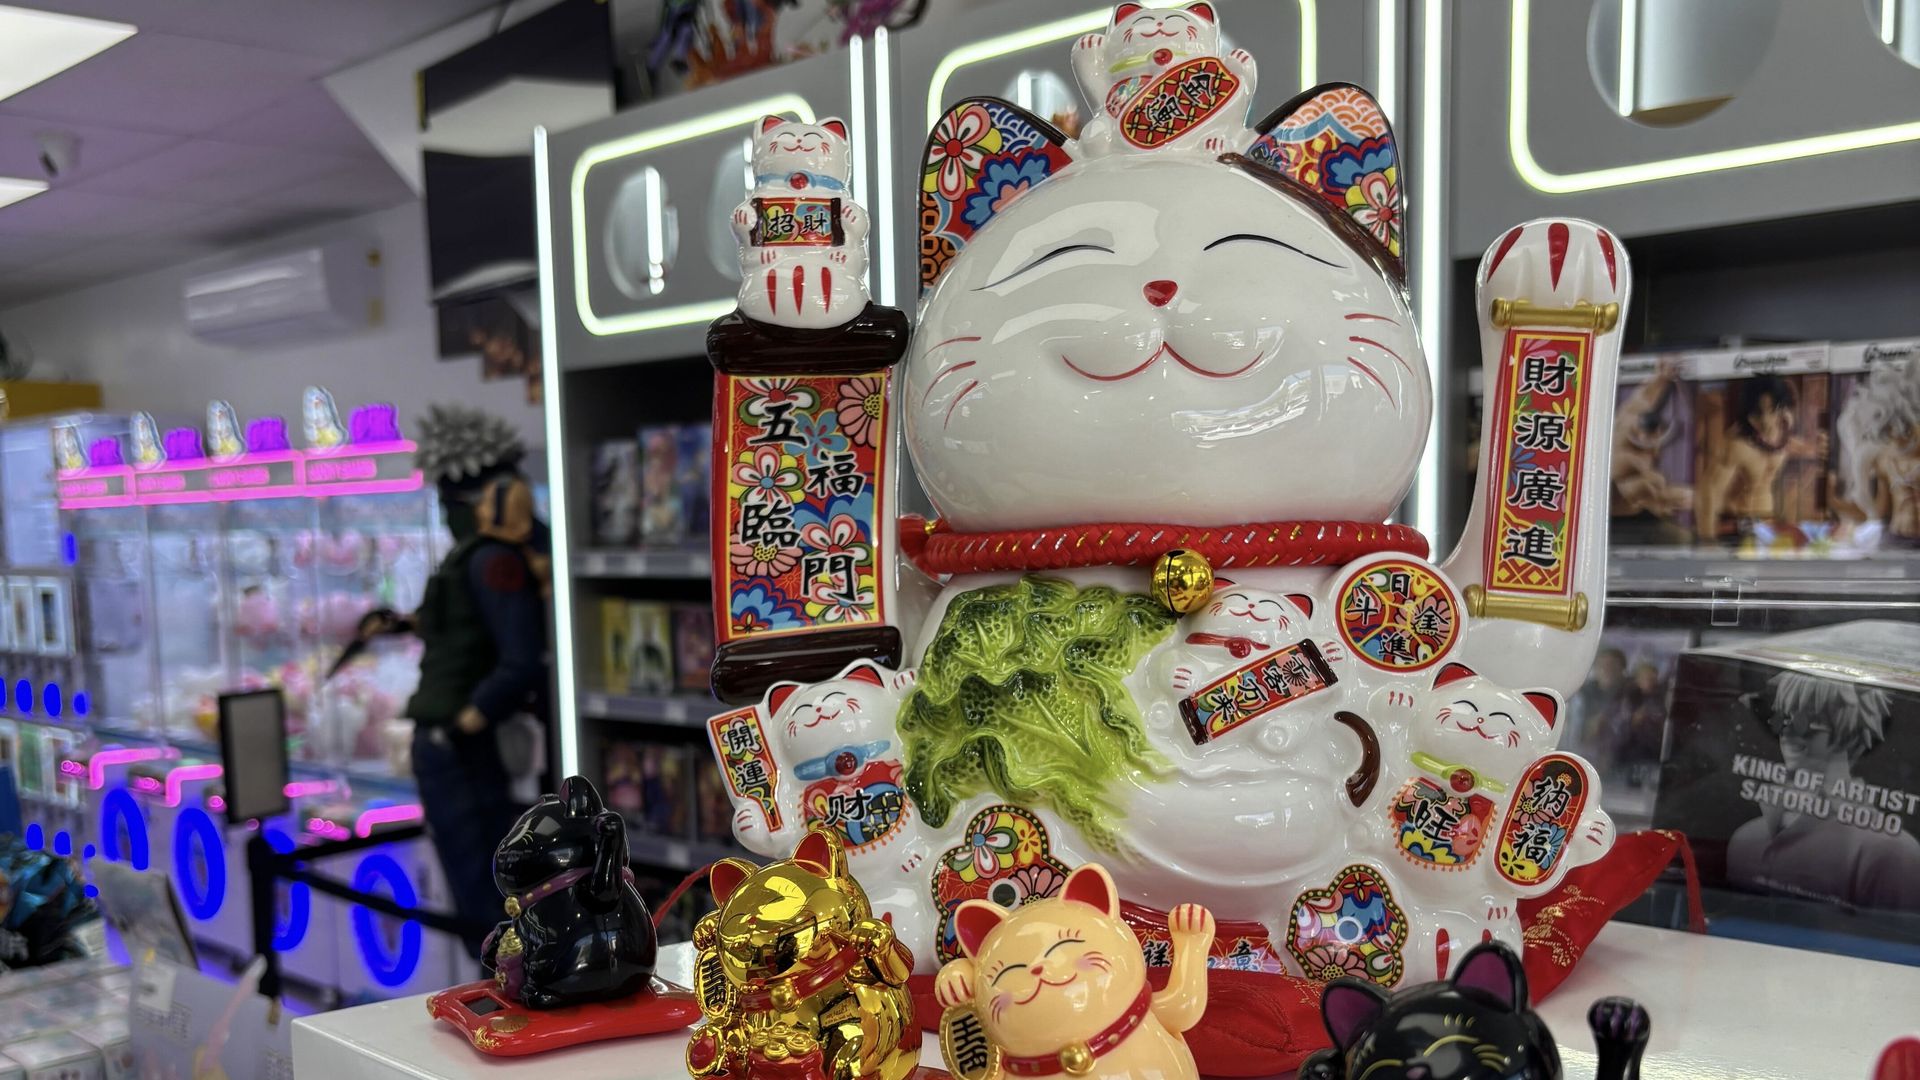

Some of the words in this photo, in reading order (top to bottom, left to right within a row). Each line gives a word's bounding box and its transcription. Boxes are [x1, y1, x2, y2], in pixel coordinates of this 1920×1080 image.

[768, 208, 828, 236] 招財
[1502, 357, 1576, 568] 財源廣進
[727, 724, 768, 789] 開運
[1732, 754, 1787, 784] KING
[1794, 768, 1825, 791] OF
[1831, 778, 1920, 816] ARTIST
[1415, 800, 1460, 842] 旺
[1740, 779, 1831, 819] SATORU
[1837, 802, 1902, 836] GOJO
